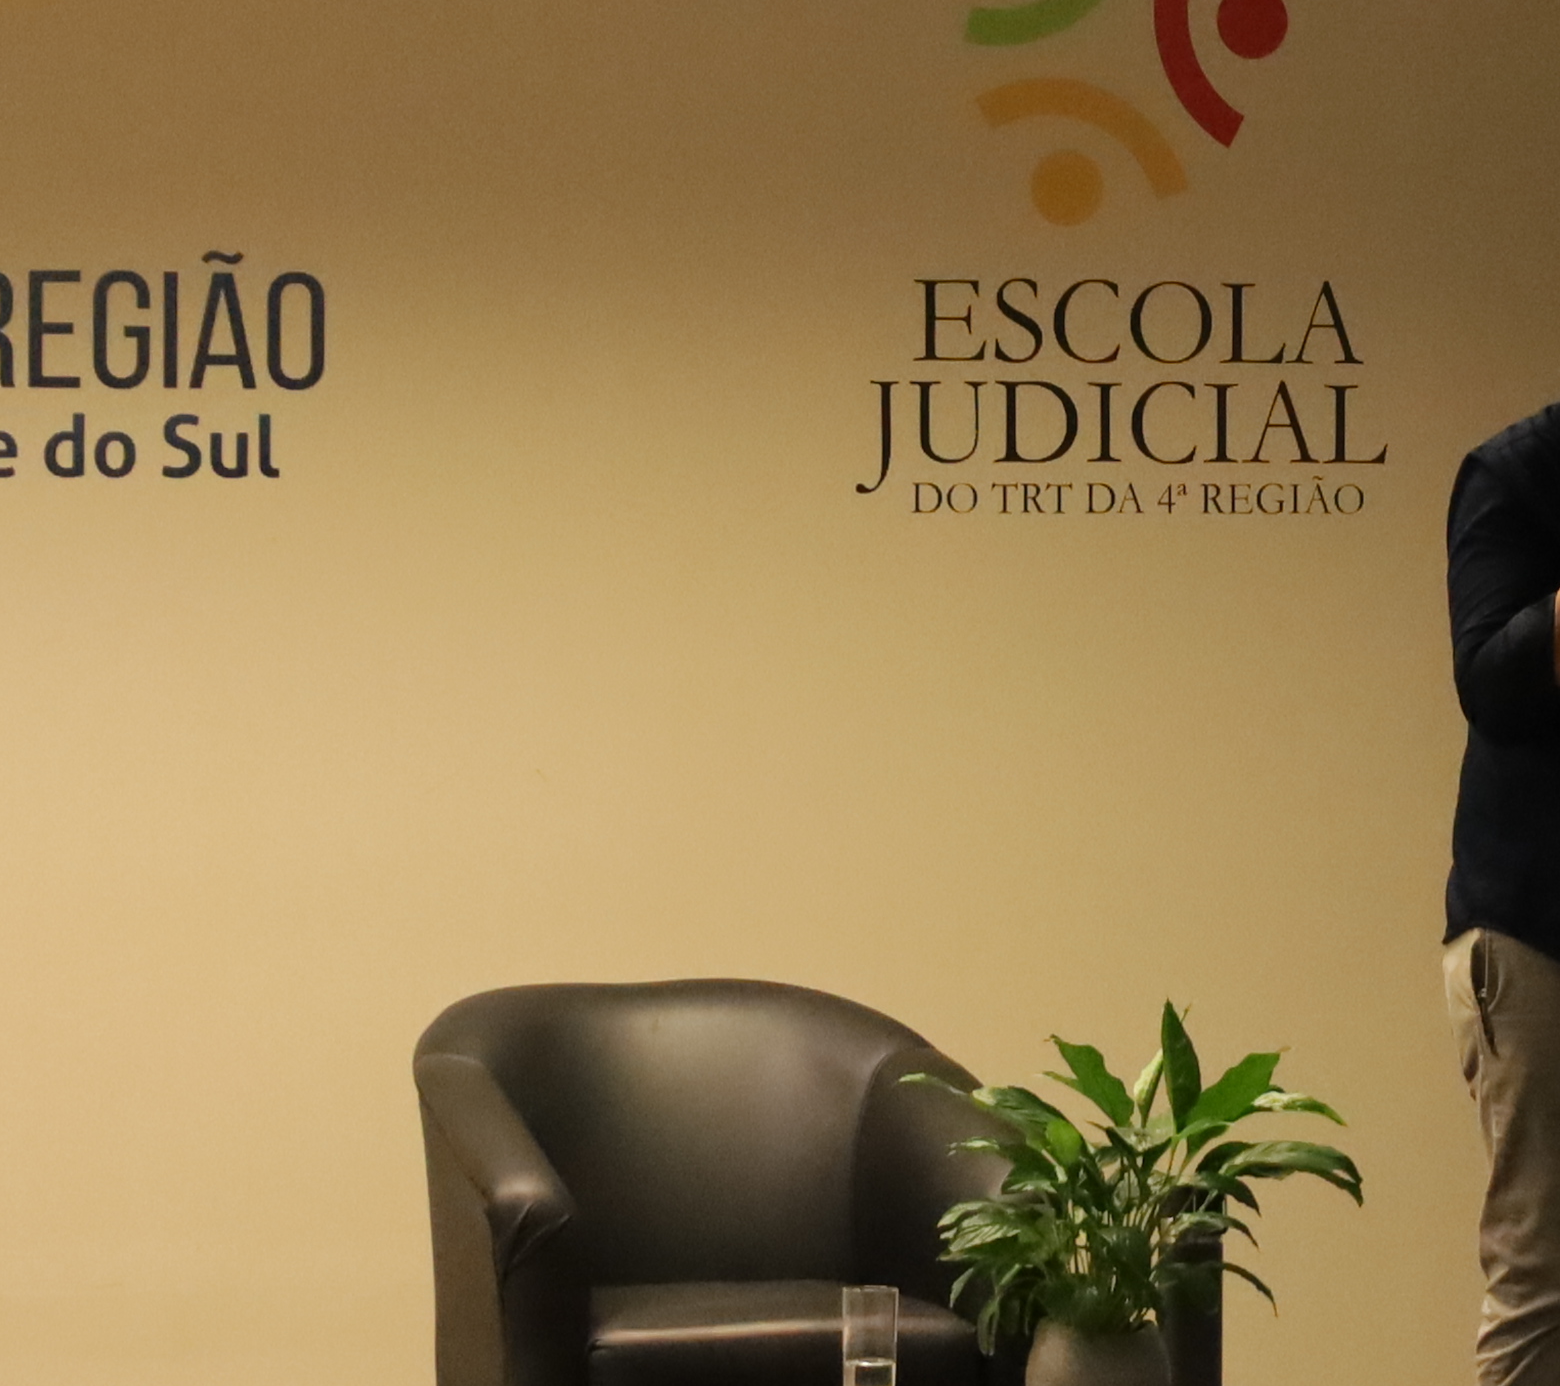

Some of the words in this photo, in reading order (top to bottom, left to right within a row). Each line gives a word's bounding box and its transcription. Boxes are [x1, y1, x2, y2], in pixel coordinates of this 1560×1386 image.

[913, 278, 1363, 365] ESCOLA
[44, 413, 136, 478] do
[162, 413, 280, 479] Sul
[856, 380, 1387, 497] JUDICIAL
[914, 482, 978, 513] DO
[992, 483, 1073, 514] TRT
[1087, 483, 1143, 514] DA
[1157, 483, 1187, 514] 4ª
[1202, 476, 1365, 515] REGIÃO
